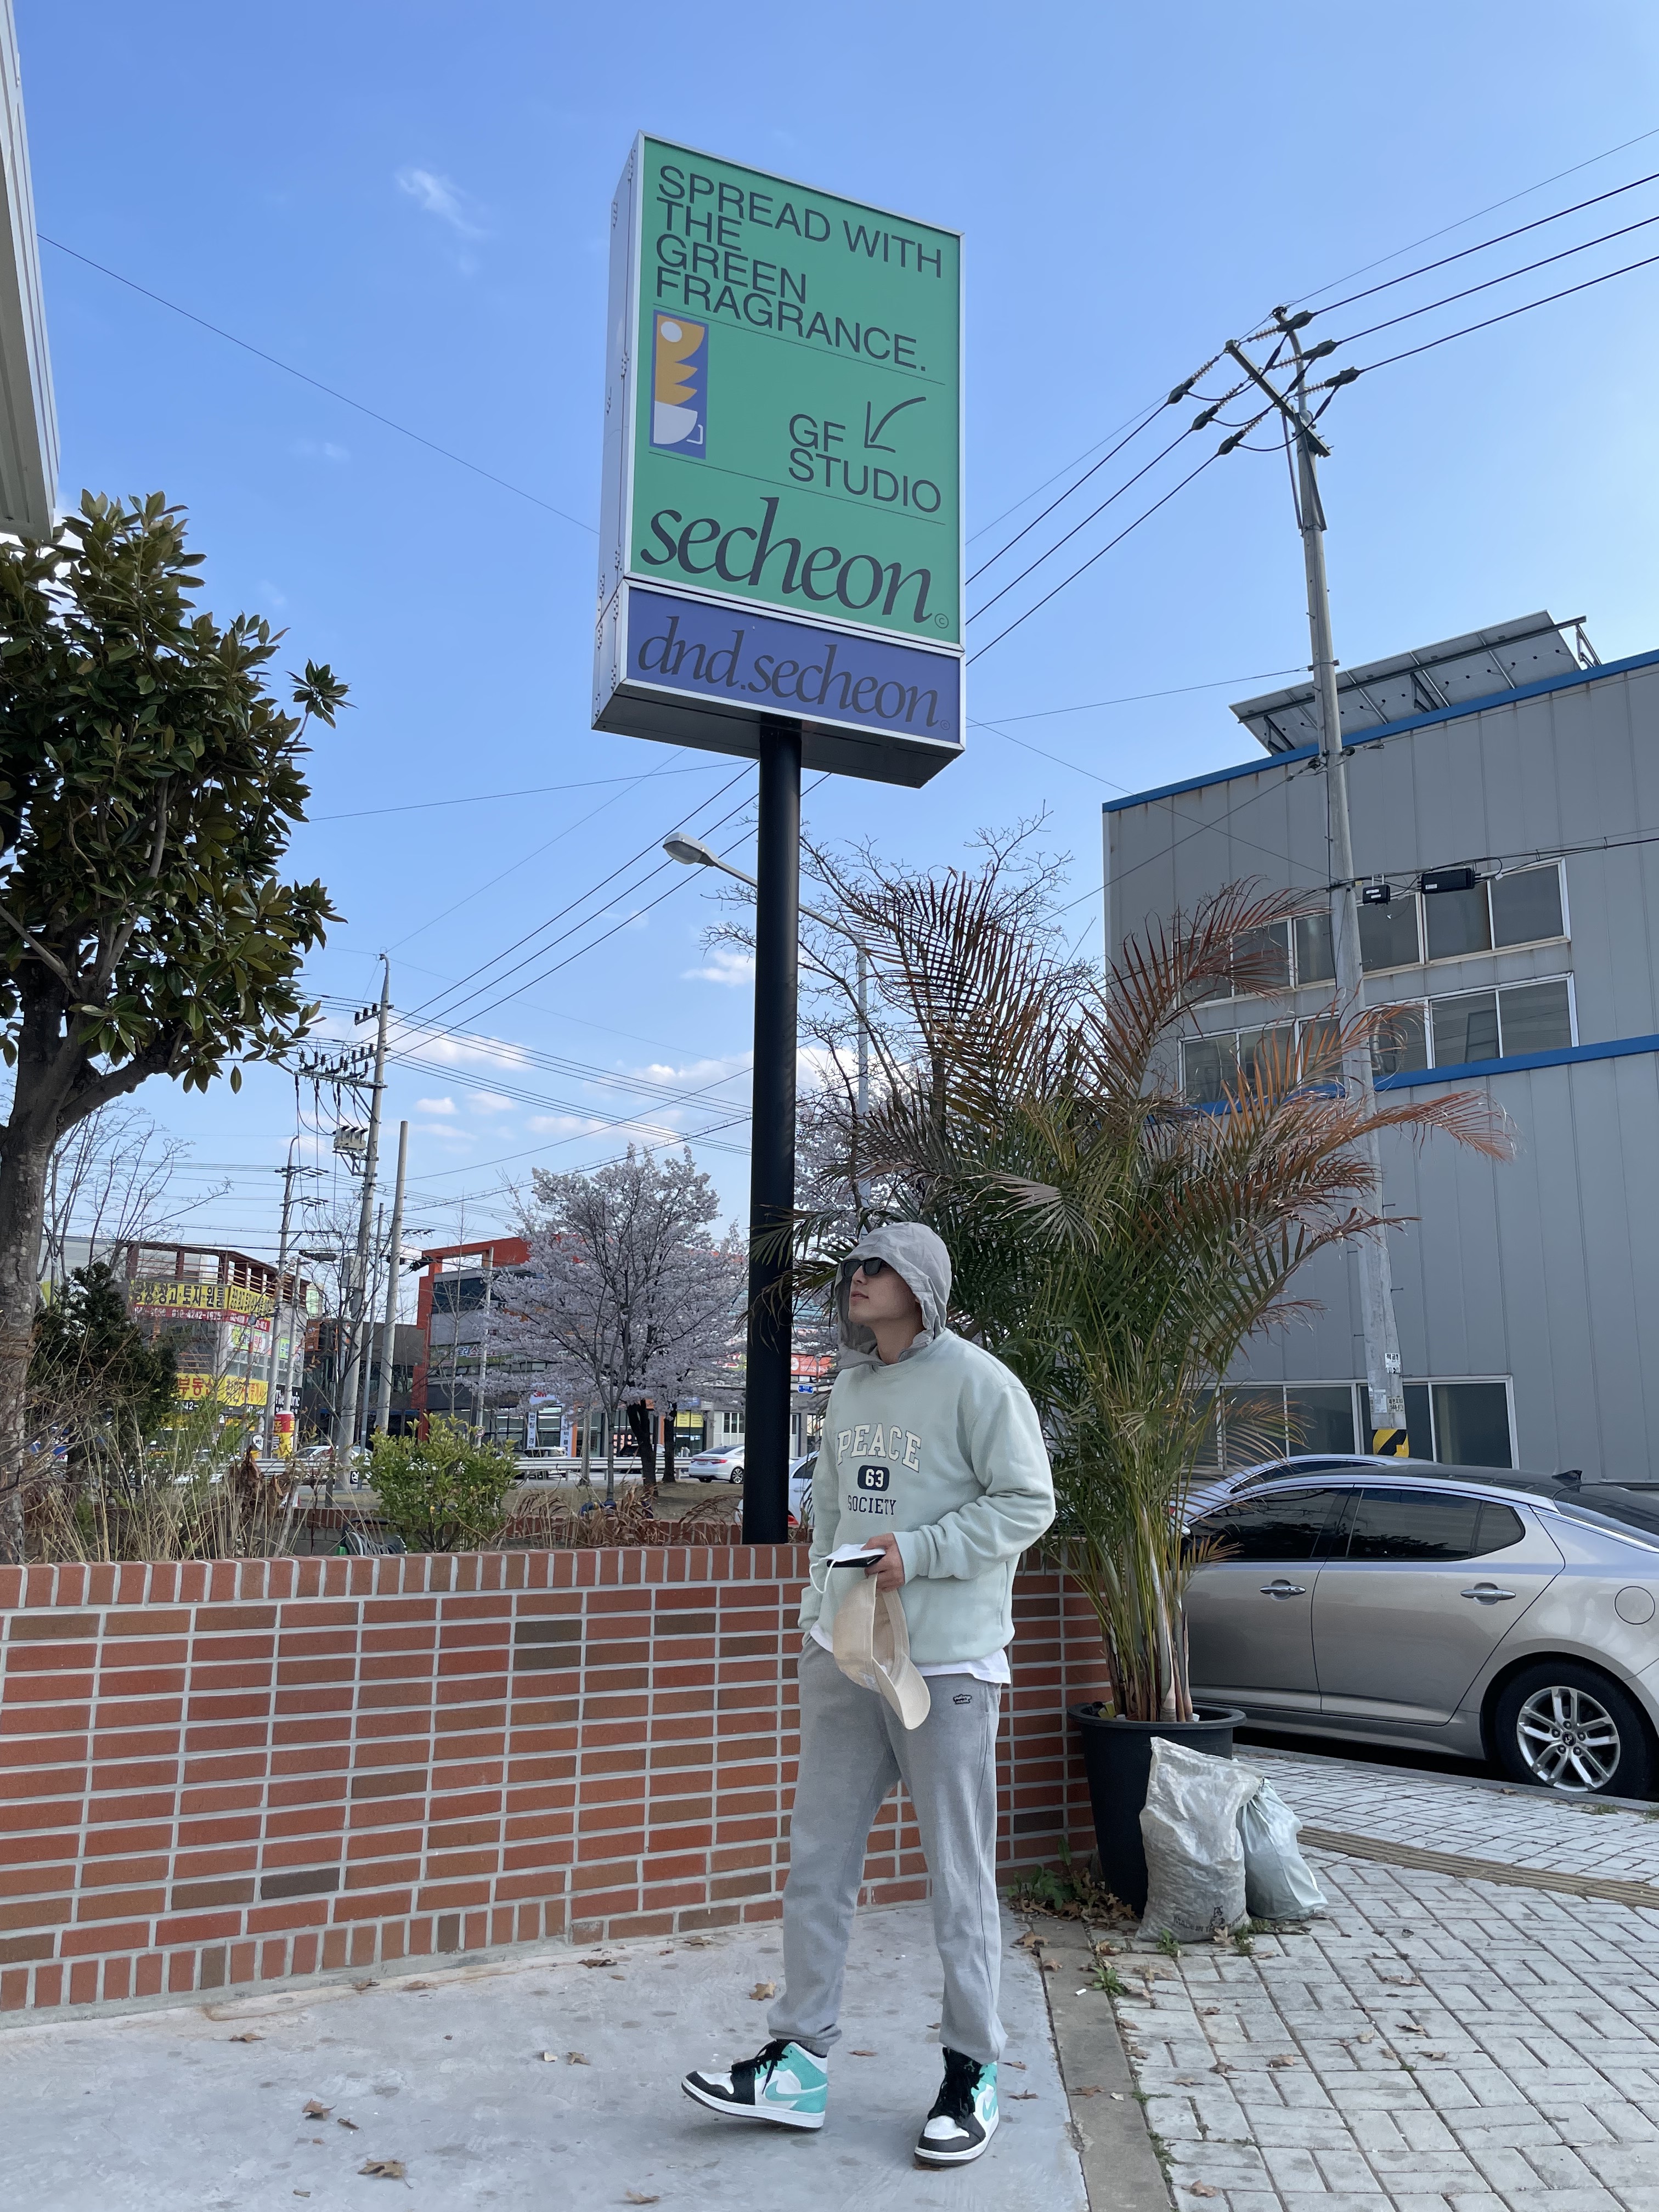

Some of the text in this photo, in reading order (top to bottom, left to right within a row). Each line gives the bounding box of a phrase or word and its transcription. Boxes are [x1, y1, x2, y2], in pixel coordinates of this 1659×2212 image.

[657, 197, 742, 251] THE
[659, 166, 942, 278] SPREAD WITH
[656, 234, 806, 304] GREEN
[656, 267, 926, 371] FRAGRANCE.
[789, 414, 845, 452] GF
[788, 448, 941, 512] STUDIO
[640, 497, 933, 623] secheon
[638, 616, 939, 727] dnd.secheon
[837, 1423, 922, 1473] PEACE
[865, 1469, 884, 1488] 63
[848, 1494, 896, 1515] SOCIETY
